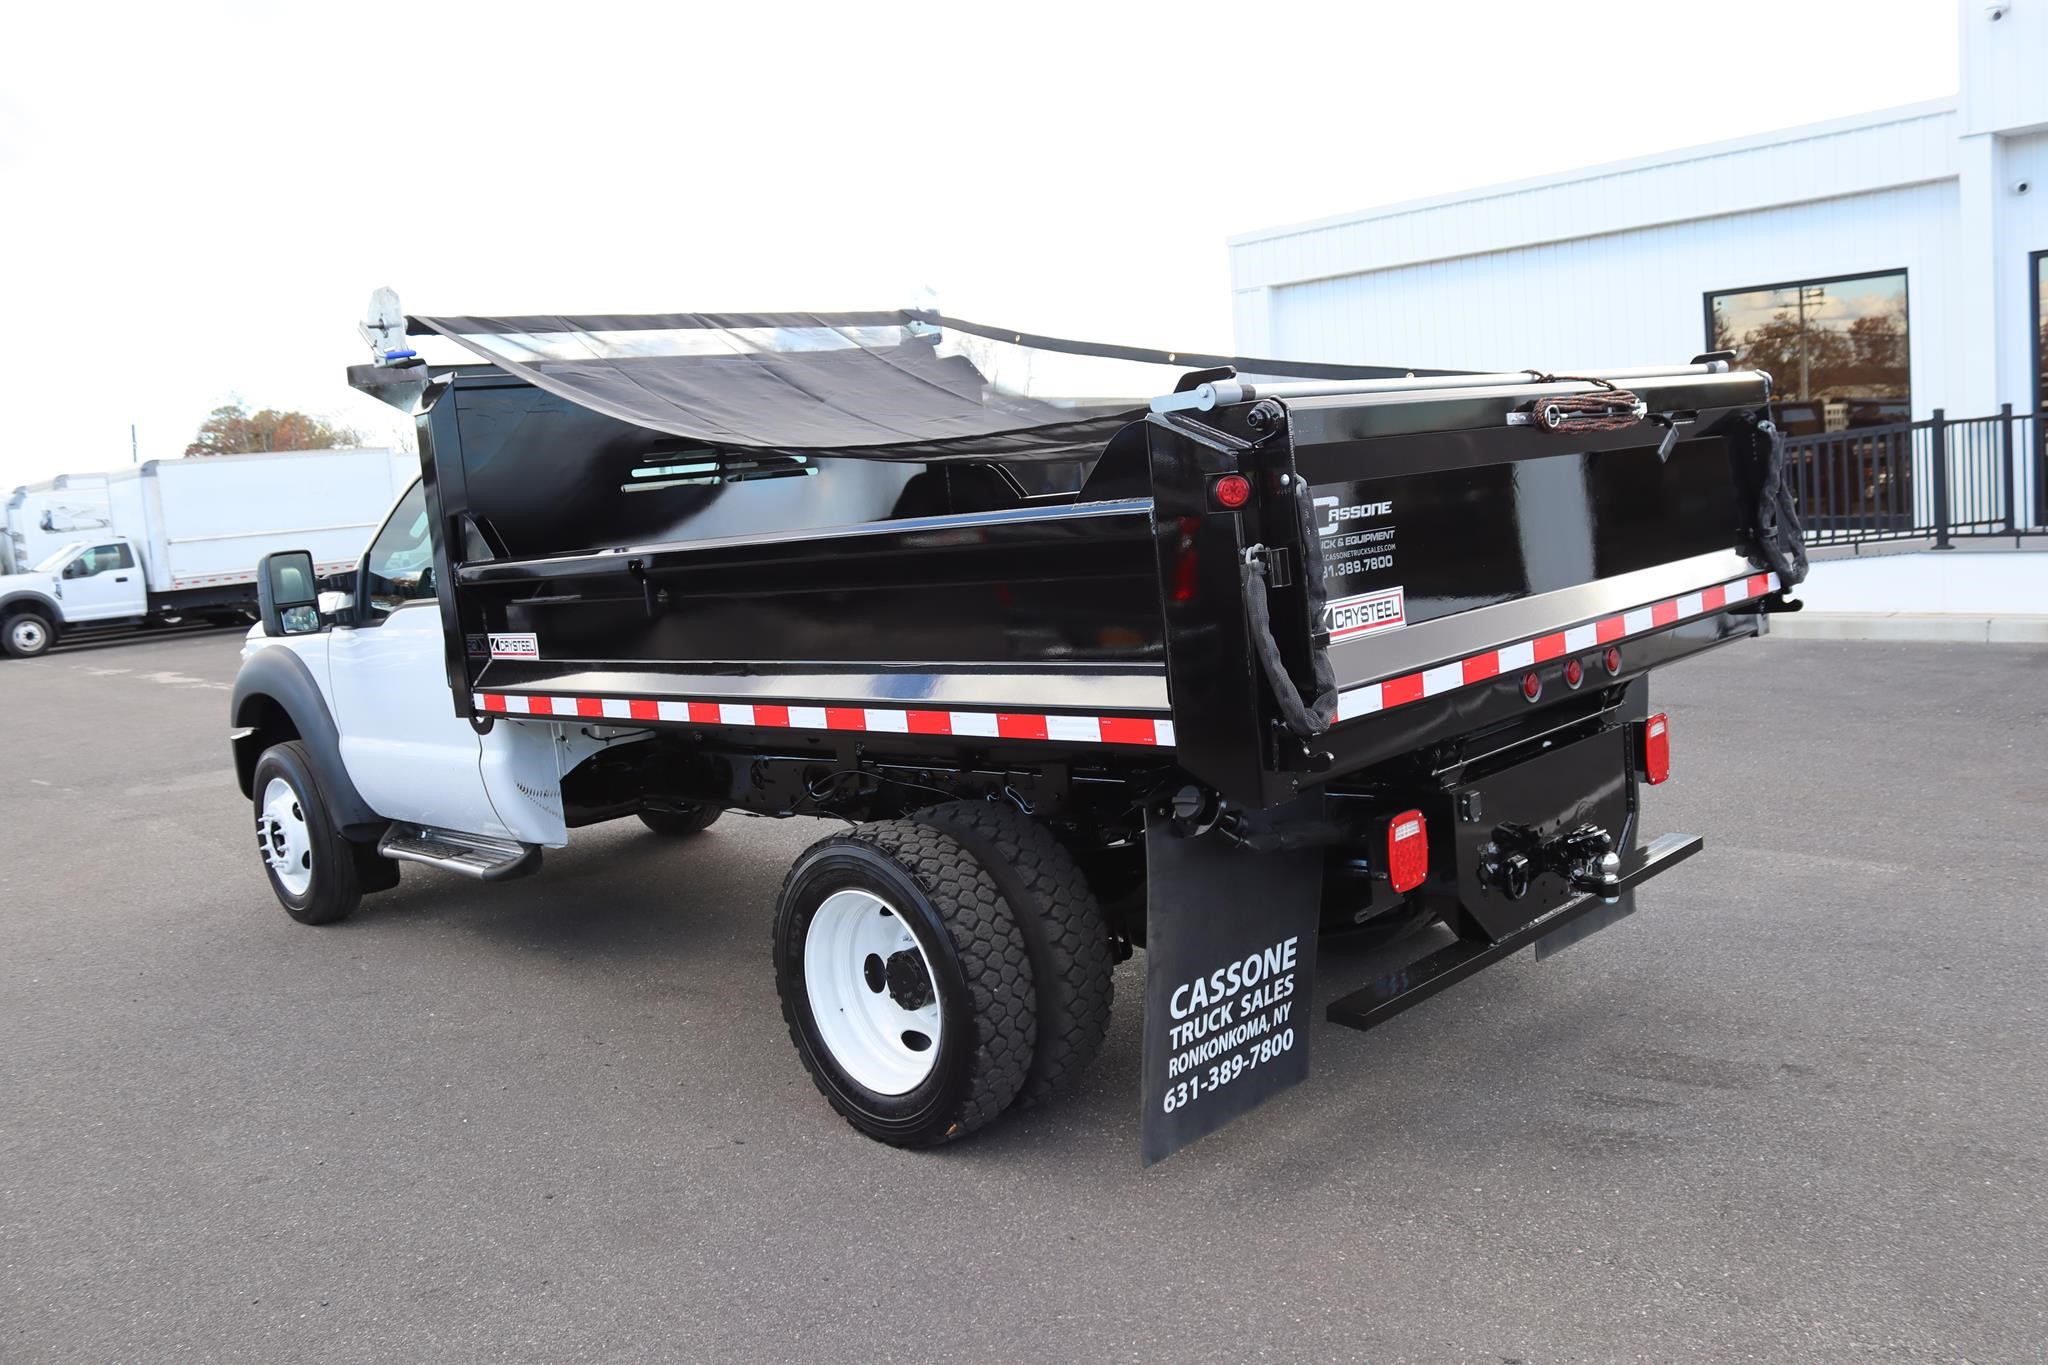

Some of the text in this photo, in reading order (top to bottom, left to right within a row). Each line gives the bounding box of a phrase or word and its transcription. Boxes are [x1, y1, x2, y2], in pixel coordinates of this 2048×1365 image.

[1323, 543, 1396, 560] CASSONETRUCKSALES.COM
[1337, 538, 1345, 547] &
[1345, 530, 1395, 546] EQUIPMENT
[1323, 555, 1393, 578] 31.389.7800
[1335, 600, 1399, 629] CRYSTEEL
[500, 640, 534, 651] CRYSTEEL
[1170, 936, 1298, 1019] CASSONE
[1169, 974, 1294, 1050] TRUCK SALES
[1168, 1001, 1292, 1079] RONKONKOMA, NY
[1163, 1028, 1294, 1114] 631-389-7800
